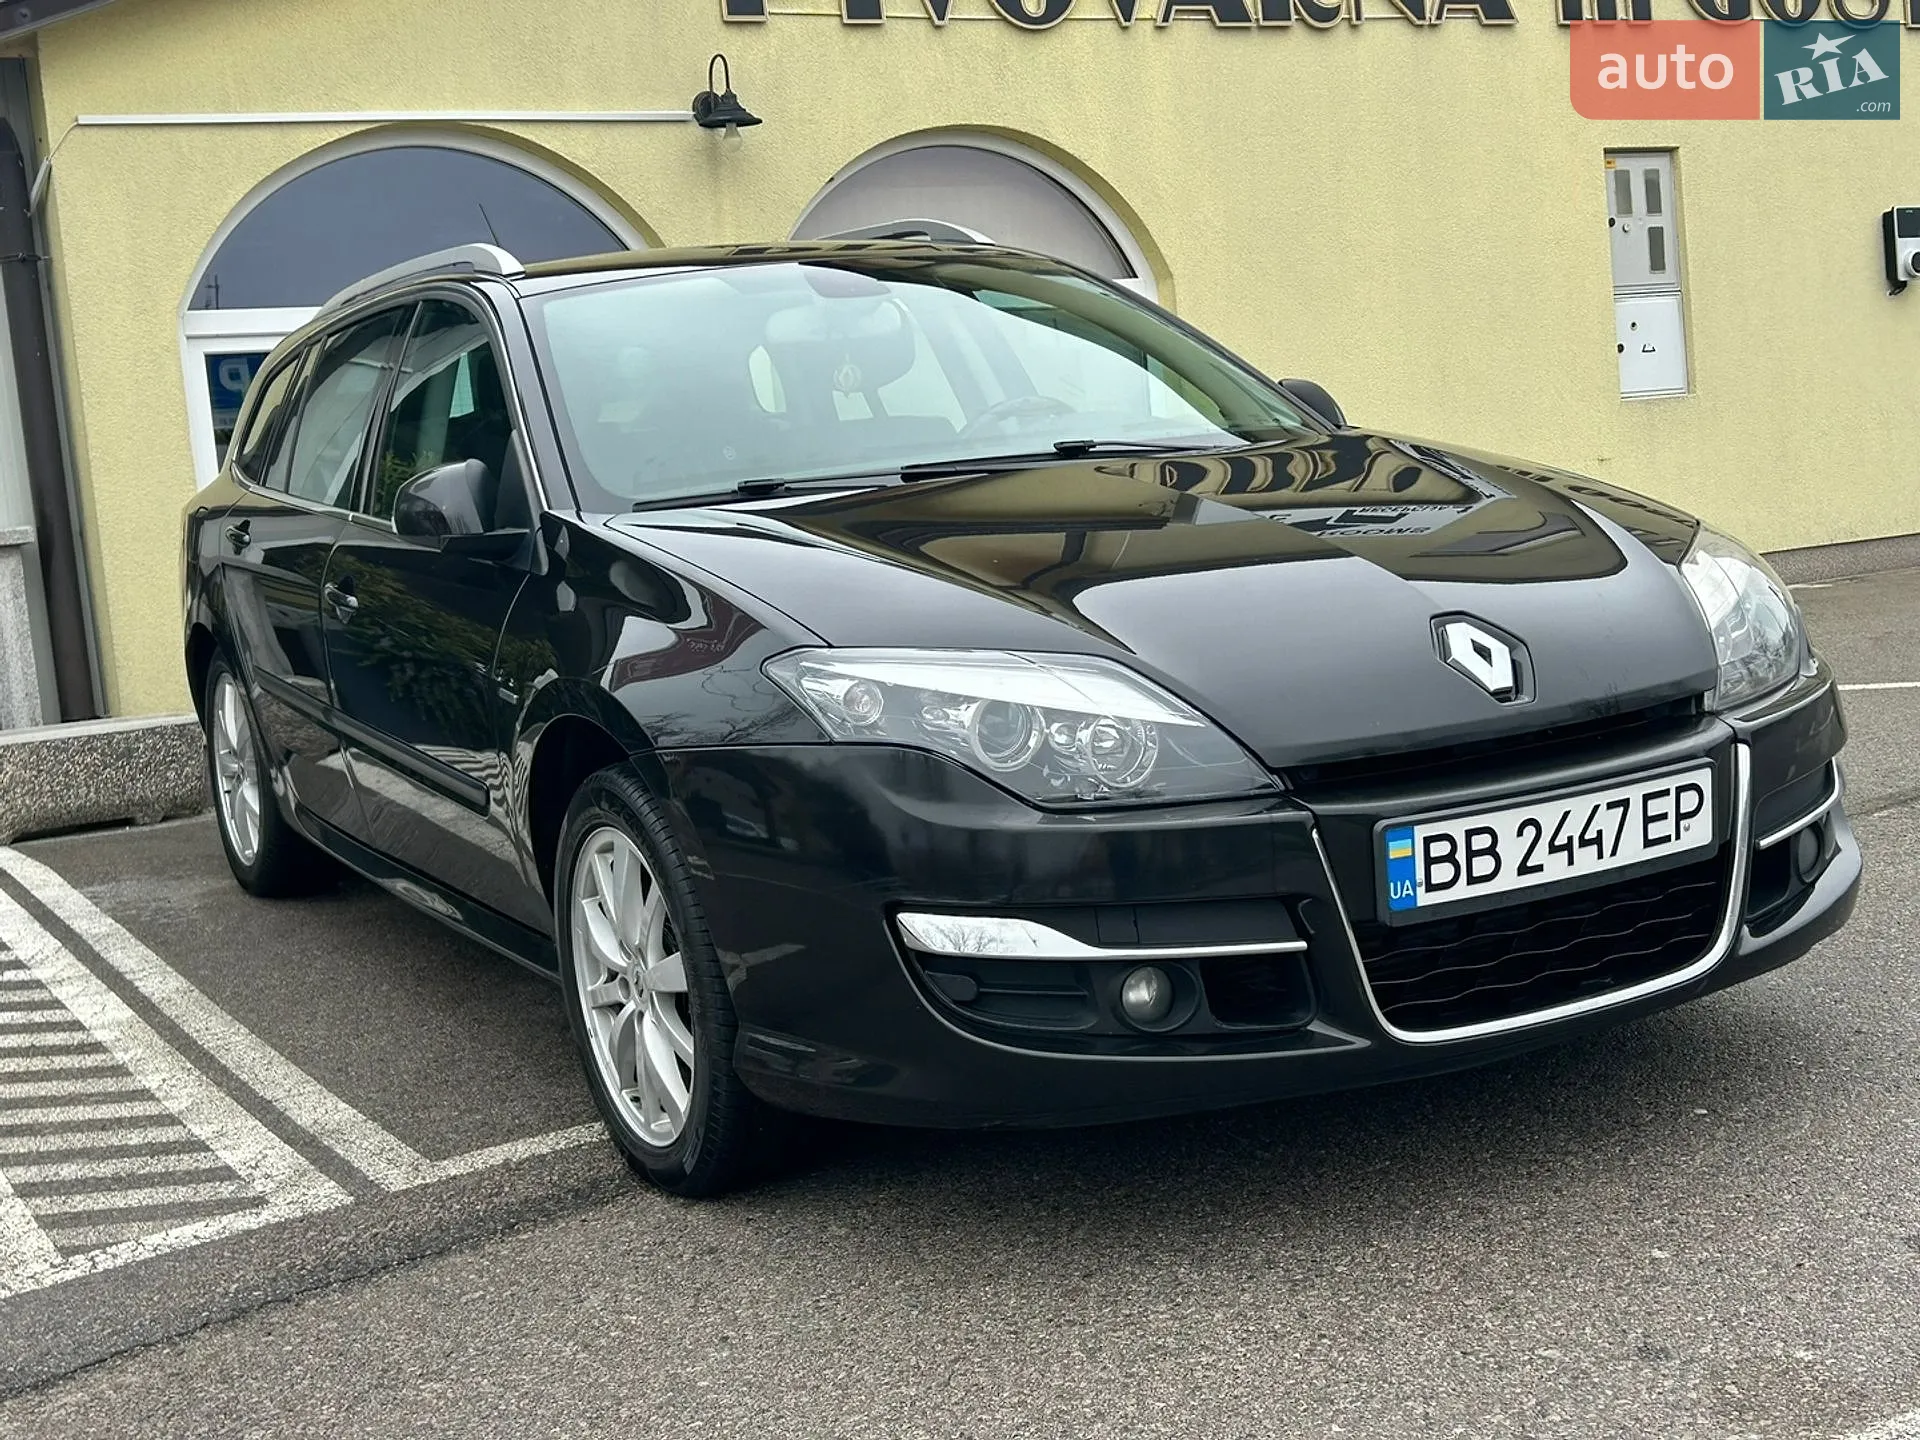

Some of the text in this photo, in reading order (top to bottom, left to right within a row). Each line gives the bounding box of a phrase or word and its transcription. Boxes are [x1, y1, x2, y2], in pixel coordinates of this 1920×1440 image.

[1422, 782, 1705, 894] BB 2447 EP
[1390, 880, 1414, 900] UA
